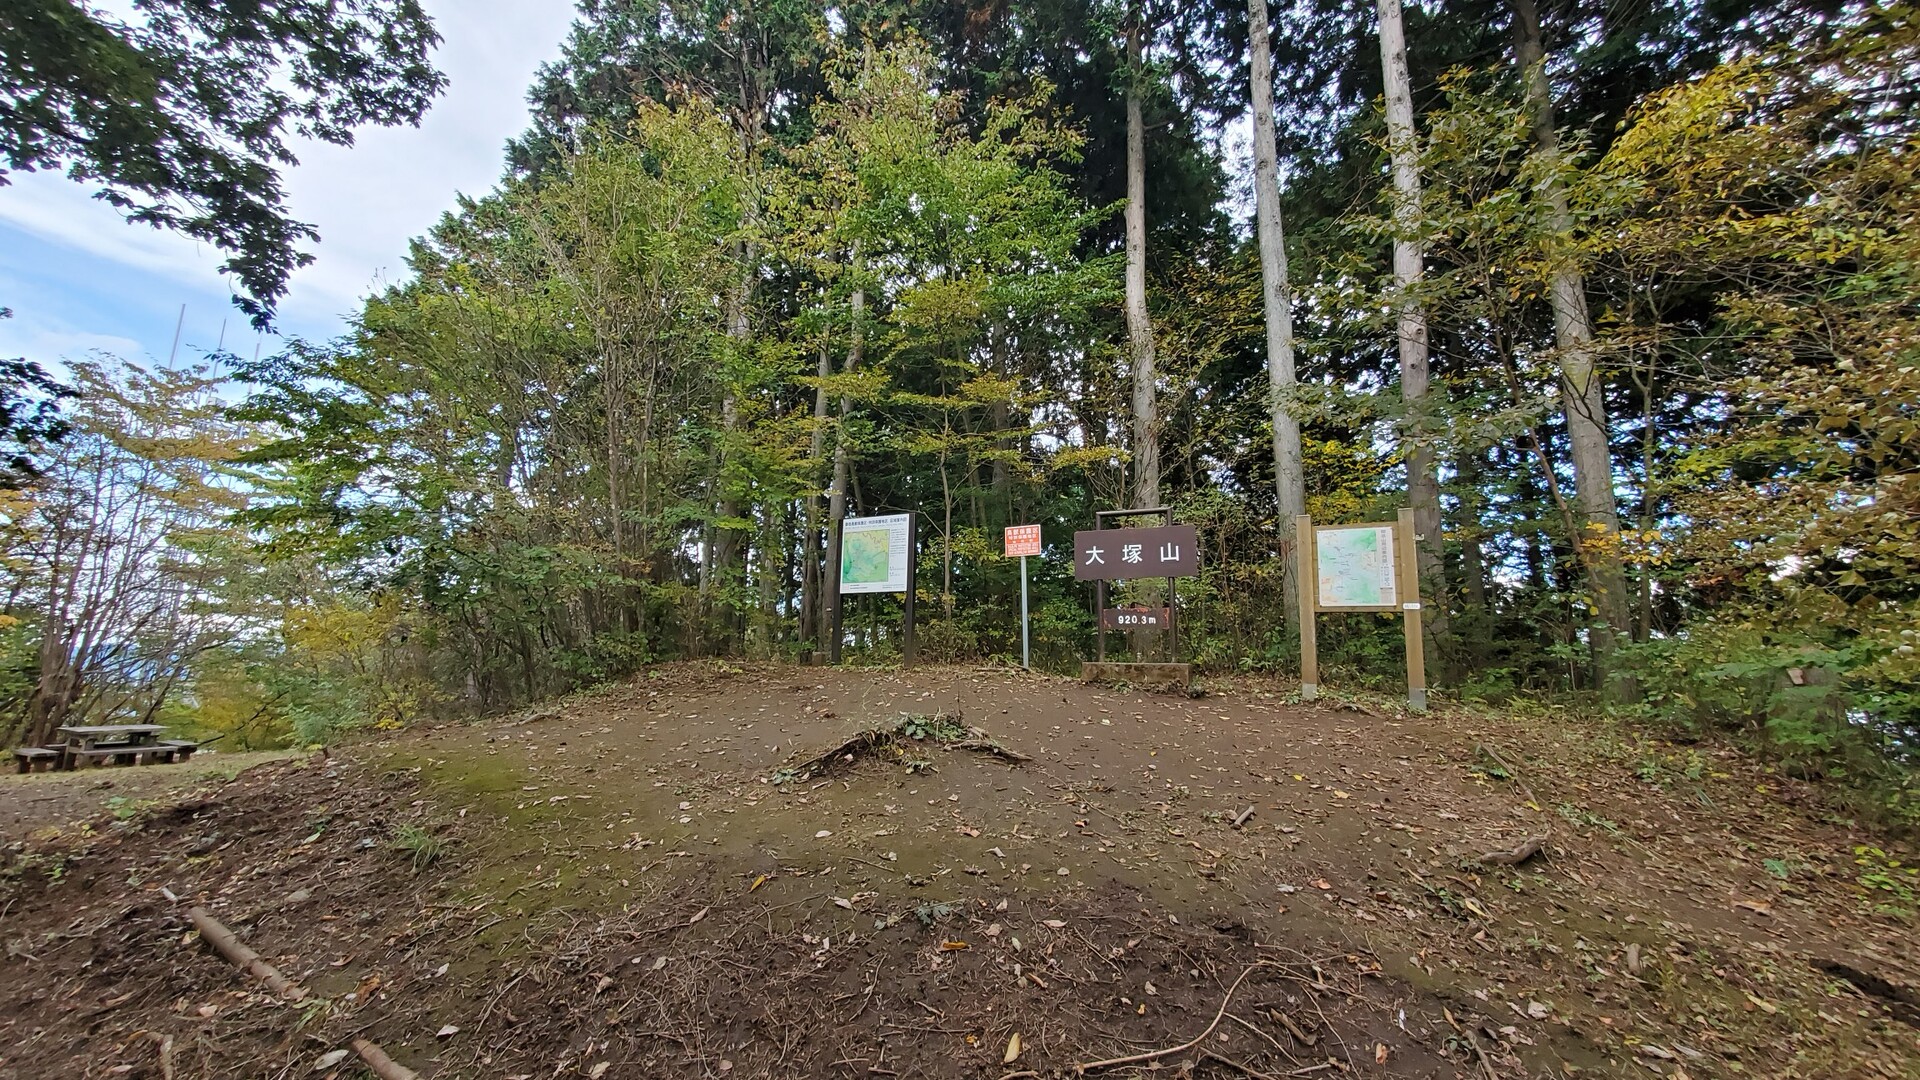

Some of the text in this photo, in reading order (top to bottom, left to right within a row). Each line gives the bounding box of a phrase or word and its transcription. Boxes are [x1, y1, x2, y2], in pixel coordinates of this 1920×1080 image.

[1085, 542, 1180, 565] 大塚山
[1118, 615, 1156, 625] 920.3m
